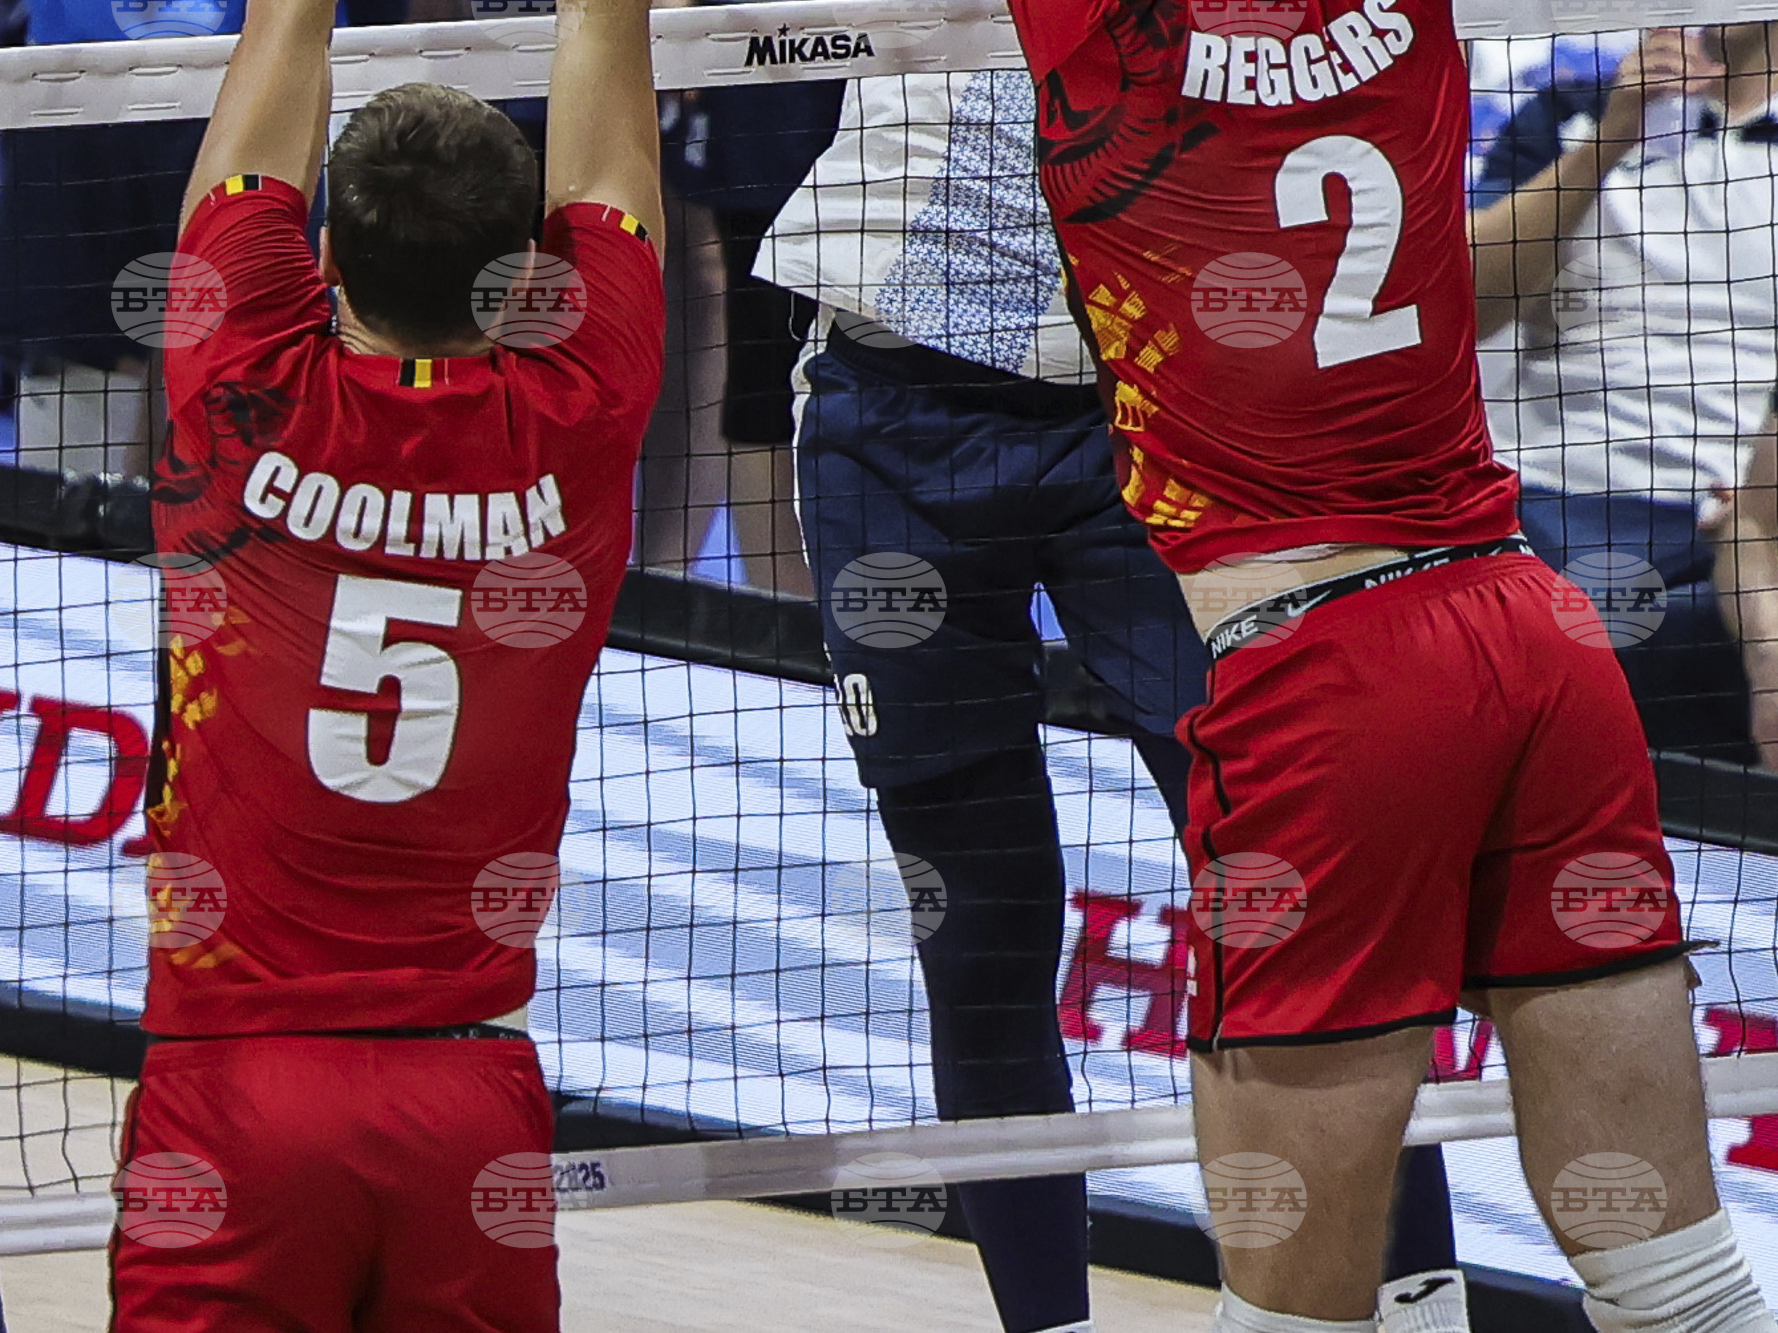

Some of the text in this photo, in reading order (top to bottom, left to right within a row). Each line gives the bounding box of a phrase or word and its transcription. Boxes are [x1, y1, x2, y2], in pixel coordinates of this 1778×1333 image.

[1274, 134, 1422, 369] 2
[243, 451, 568, 560] COOLMAN
[307, 574, 463, 803] 5
[1211, 614, 1258, 659] NIKE
